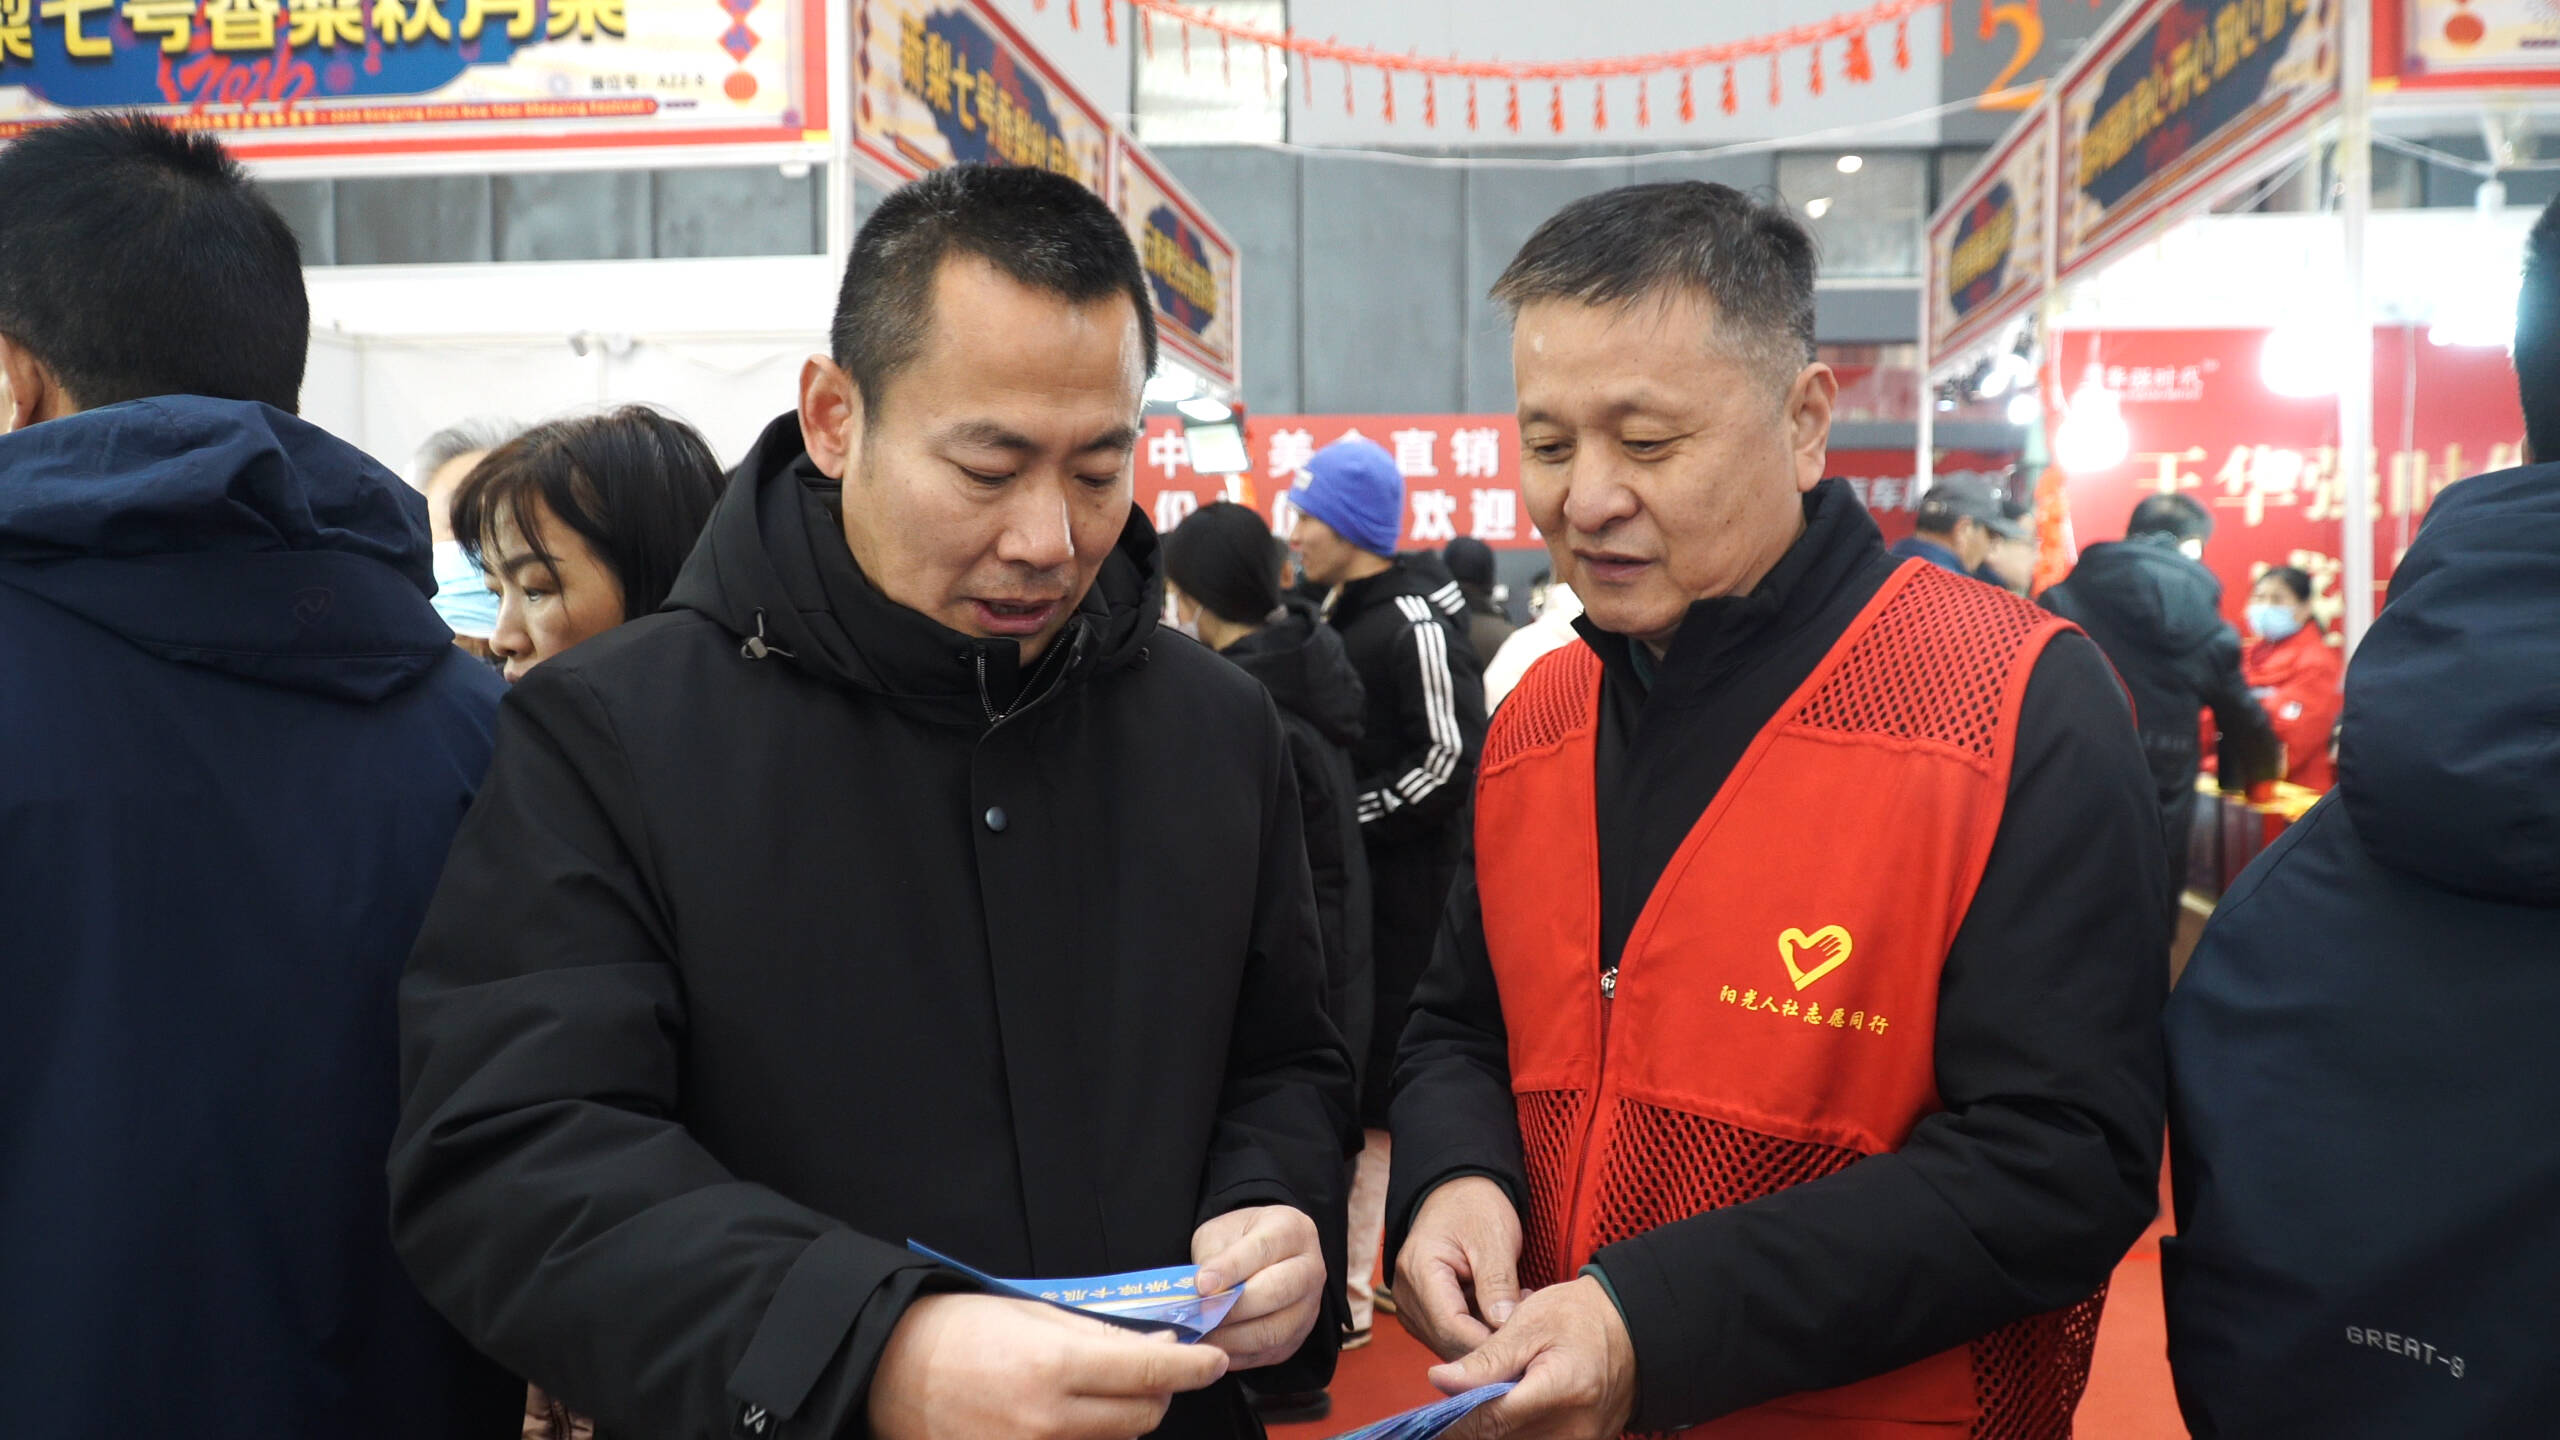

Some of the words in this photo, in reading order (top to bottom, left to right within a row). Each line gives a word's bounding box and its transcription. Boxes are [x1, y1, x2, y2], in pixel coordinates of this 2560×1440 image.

[1719, 984, 1889, 1035] 阳光人社志愿同行
